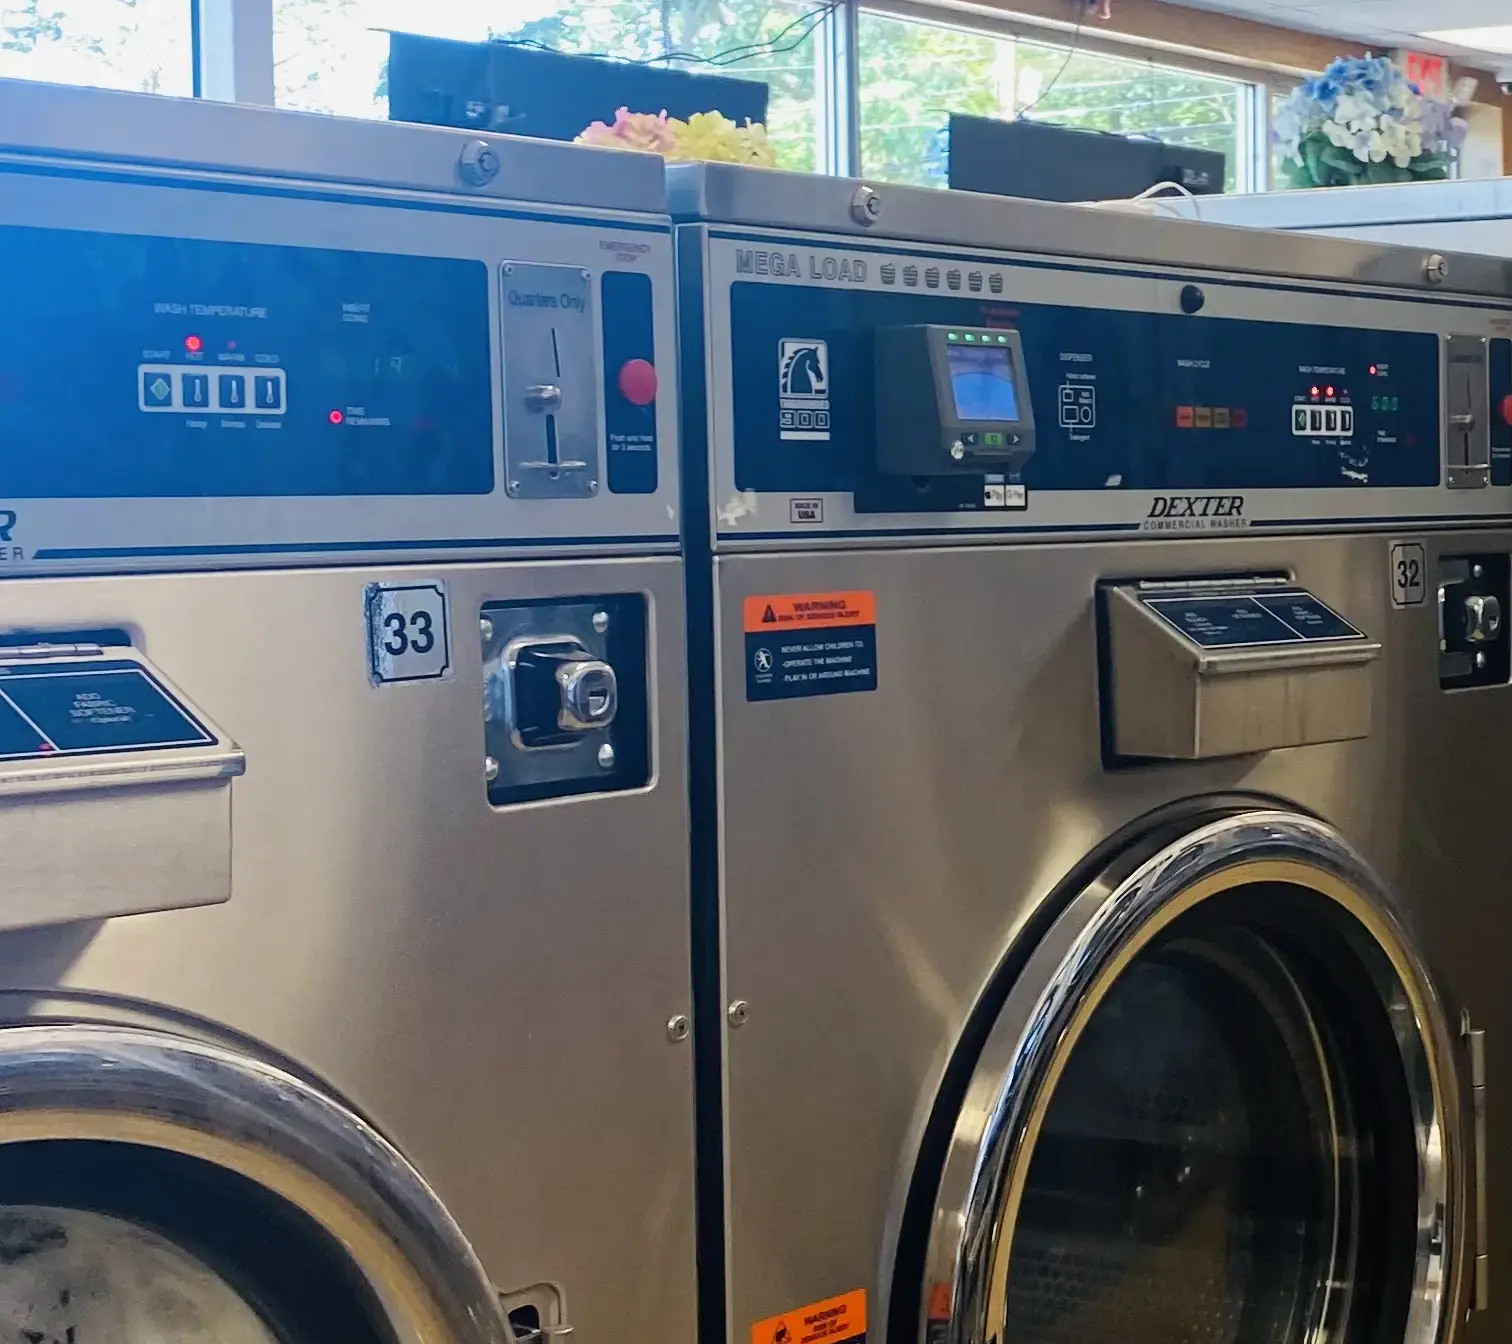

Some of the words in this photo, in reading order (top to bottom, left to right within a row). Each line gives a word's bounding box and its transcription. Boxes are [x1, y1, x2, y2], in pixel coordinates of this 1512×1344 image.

[736, 249, 801, 278] MEGA
[809, 256, 868, 282] LOAD
[560, 293, 586, 313] Only
[798, 510, 816, 519] USA
[1147, 496, 1244, 517] DEXTER
[1144, 520, 1206, 531] COMMERCIAL
[1210, 519, 1248, 529] WASHER
[1398, 559, 1420, 588] 32
[384, 611, 435, 656] 33
